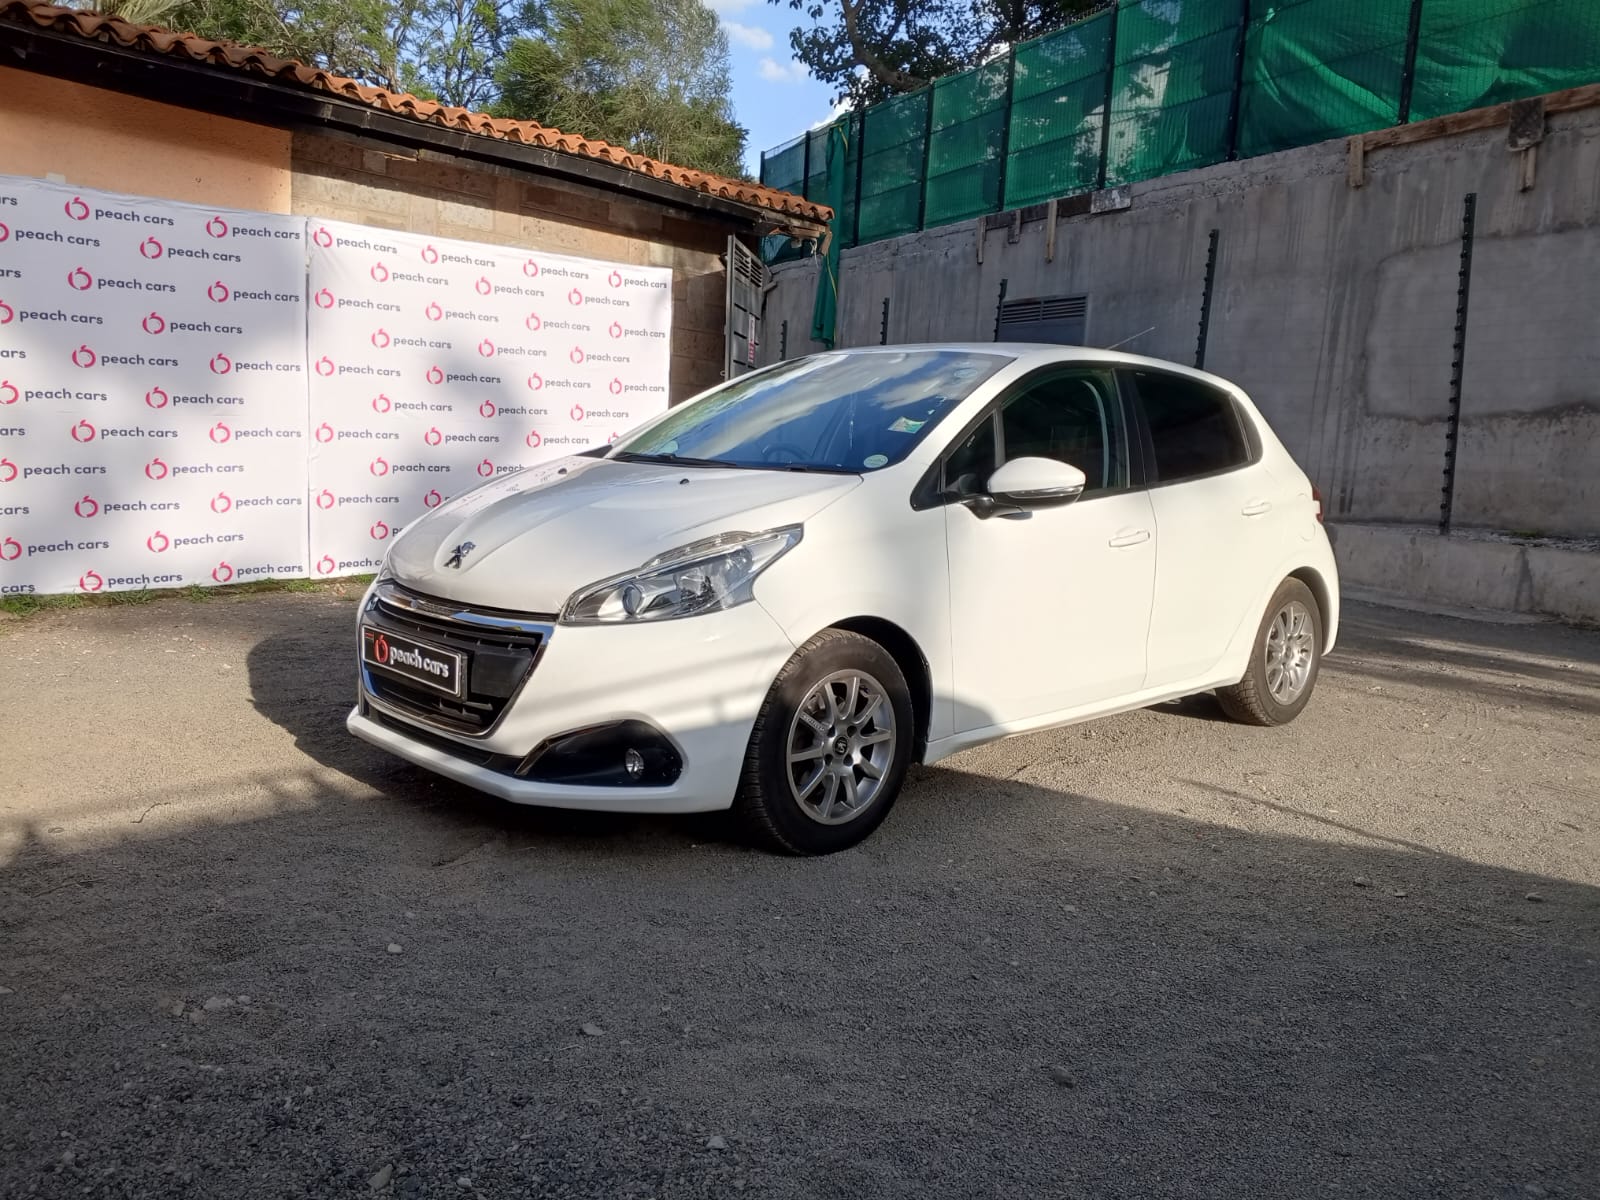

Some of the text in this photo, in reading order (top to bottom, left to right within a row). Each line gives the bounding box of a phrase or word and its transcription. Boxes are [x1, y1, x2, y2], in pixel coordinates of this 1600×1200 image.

[95, 209, 174, 226] peach cars
[15, 230, 100, 247] peach cars
[232, 227, 300, 239] peach cars
[336, 238, 397, 254] peach cars
[168, 248, 241, 262] peach cars
[442, 255, 495, 267] peach cars
[0, 269, 21, 278] ars
[541, 268, 568, 276] peach
[98, 278, 176, 292] peach cars
[392, 273, 448, 285] peach cars
[624, 279, 649, 287] peach
[234, 290, 299, 302] peach cars
[495, 286, 523, 295] peach
[338, 299, 374, 309] peach
[20, 310, 103, 324] peach cars
[446, 311, 475, 320] peach
[170, 321, 242, 334] peach cars
[544, 321, 569, 329] peach
[625, 329, 648, 337] peach
[394, 338, 451, 349] peach cars
[0, 350, 26, 359] ars
[498, 347, 525, 355] peach
[101, 354, 178, 366] peach cars
[587, 354, 611, 362] peach
[235, 361, 272, 372] peach
[339, 365, 374, 375] peach
[446, 372, 477, 382] peach
[545, 379, 571, 388] peach
[625, 384, 647, 392] peach
[25, 388, 107, 402] peach cars
[173, 394, 213, 406] peach
[395, 402, 427, 411] peach
[498, 406, 526, 416] peach
[586, 409, 610, 418] peach
[0, 428, 25, 437] ars
[101, 426, 144, 440] peach
[235, 428, 273, 440] peach
[338, 429, 372, 440] peach
[445, 433, 476, 444] peach
[544, 436, 569, 446] peach
[24, 464, 70, 479] peach
[173, 463, 213, 477] peach
[393, 463, 425, 474] peach
[236, 496, 273, 509] peach
[339, 494, 372, 506] peach
[104, 501, 147, 515] peach
[174, 534, 244, 549] peach cars
[28, 540, 109, 557] peach cars
[339, 558, 372, 570] peach
[237, 564, 274, 578] peach
[108, 573, 183, 588] peach cars
[1, 584, 35, 594] cars
[390, 645, 449, 678] peach cars
